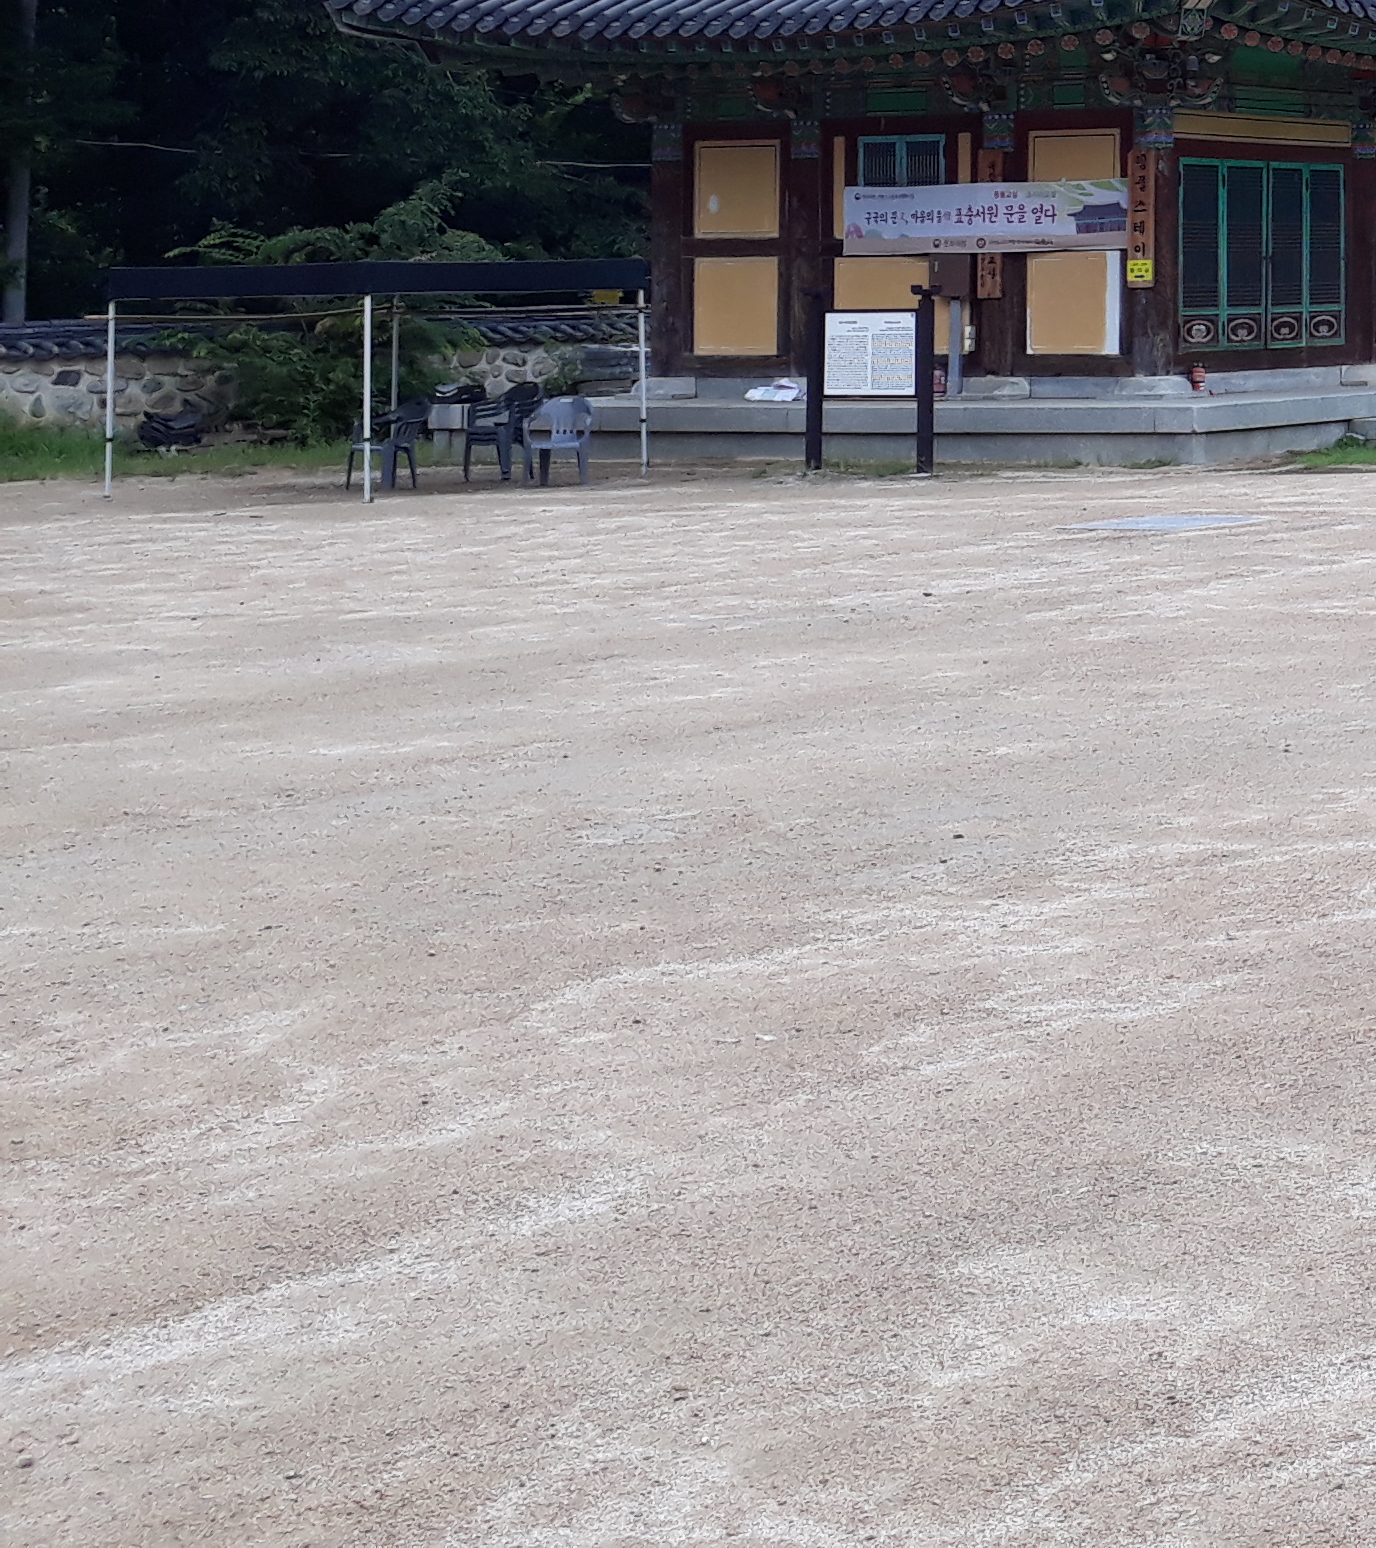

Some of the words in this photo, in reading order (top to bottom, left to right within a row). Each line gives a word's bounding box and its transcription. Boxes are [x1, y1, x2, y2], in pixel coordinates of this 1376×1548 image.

[910, 209, 934, 224] 마음의
[954, 203, 999, 226] 표충서원
[1003, 203, 1027, 224] 문을
[1031, 203, 1058, 225] 열다
[1133, 153, 1148, 257] 템플스테이
